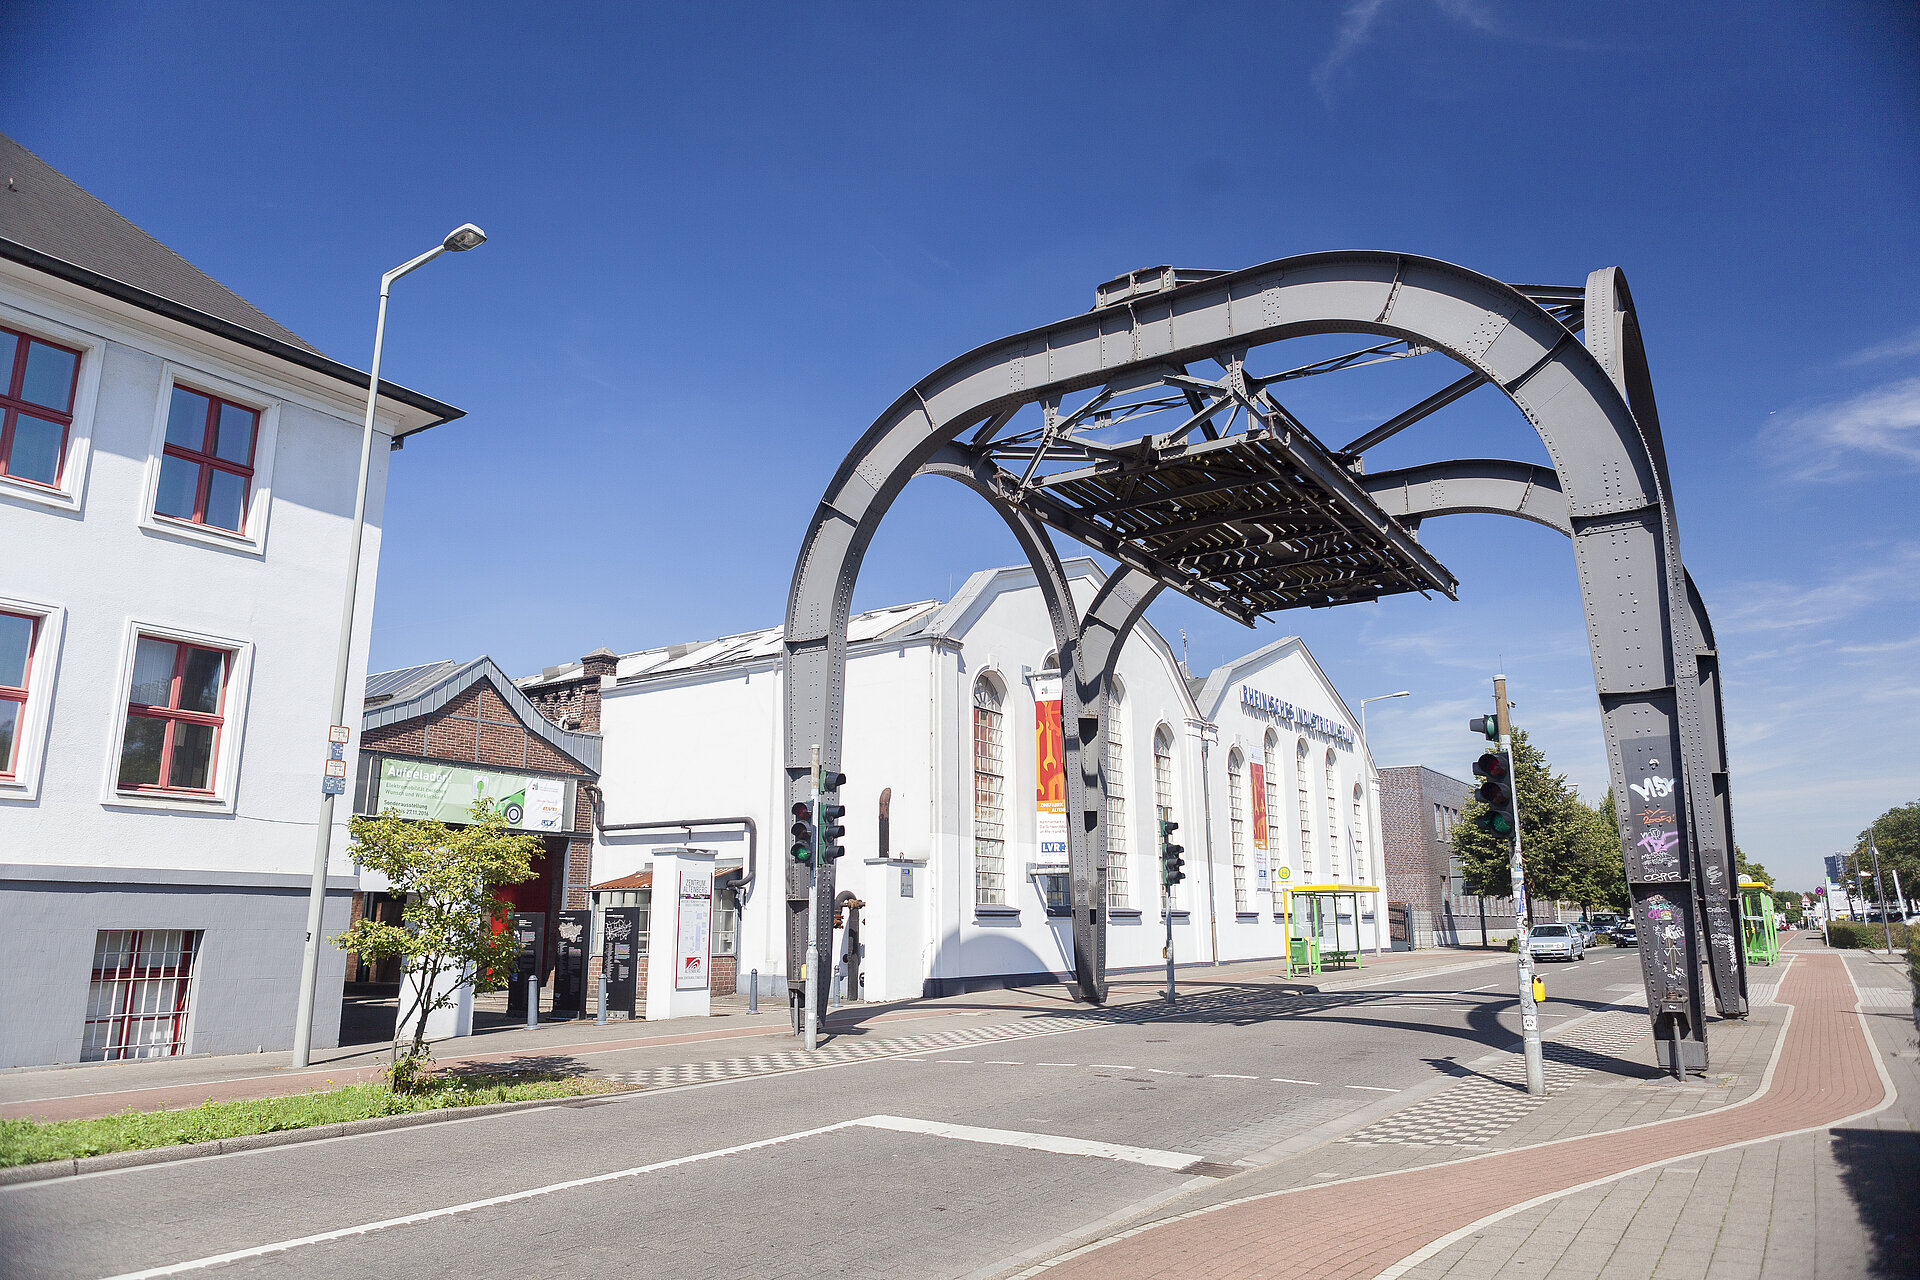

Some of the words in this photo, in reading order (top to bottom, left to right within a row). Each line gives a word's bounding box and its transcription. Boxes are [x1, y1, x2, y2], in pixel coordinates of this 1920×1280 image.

[1241, 685, 1294, 719] RHEINISCHES
[1042, 843, 1061, 852] LVR
[685, 878, 706, 886] ZENTRUM
[682, 885, 708, 893] ALTENBERG
